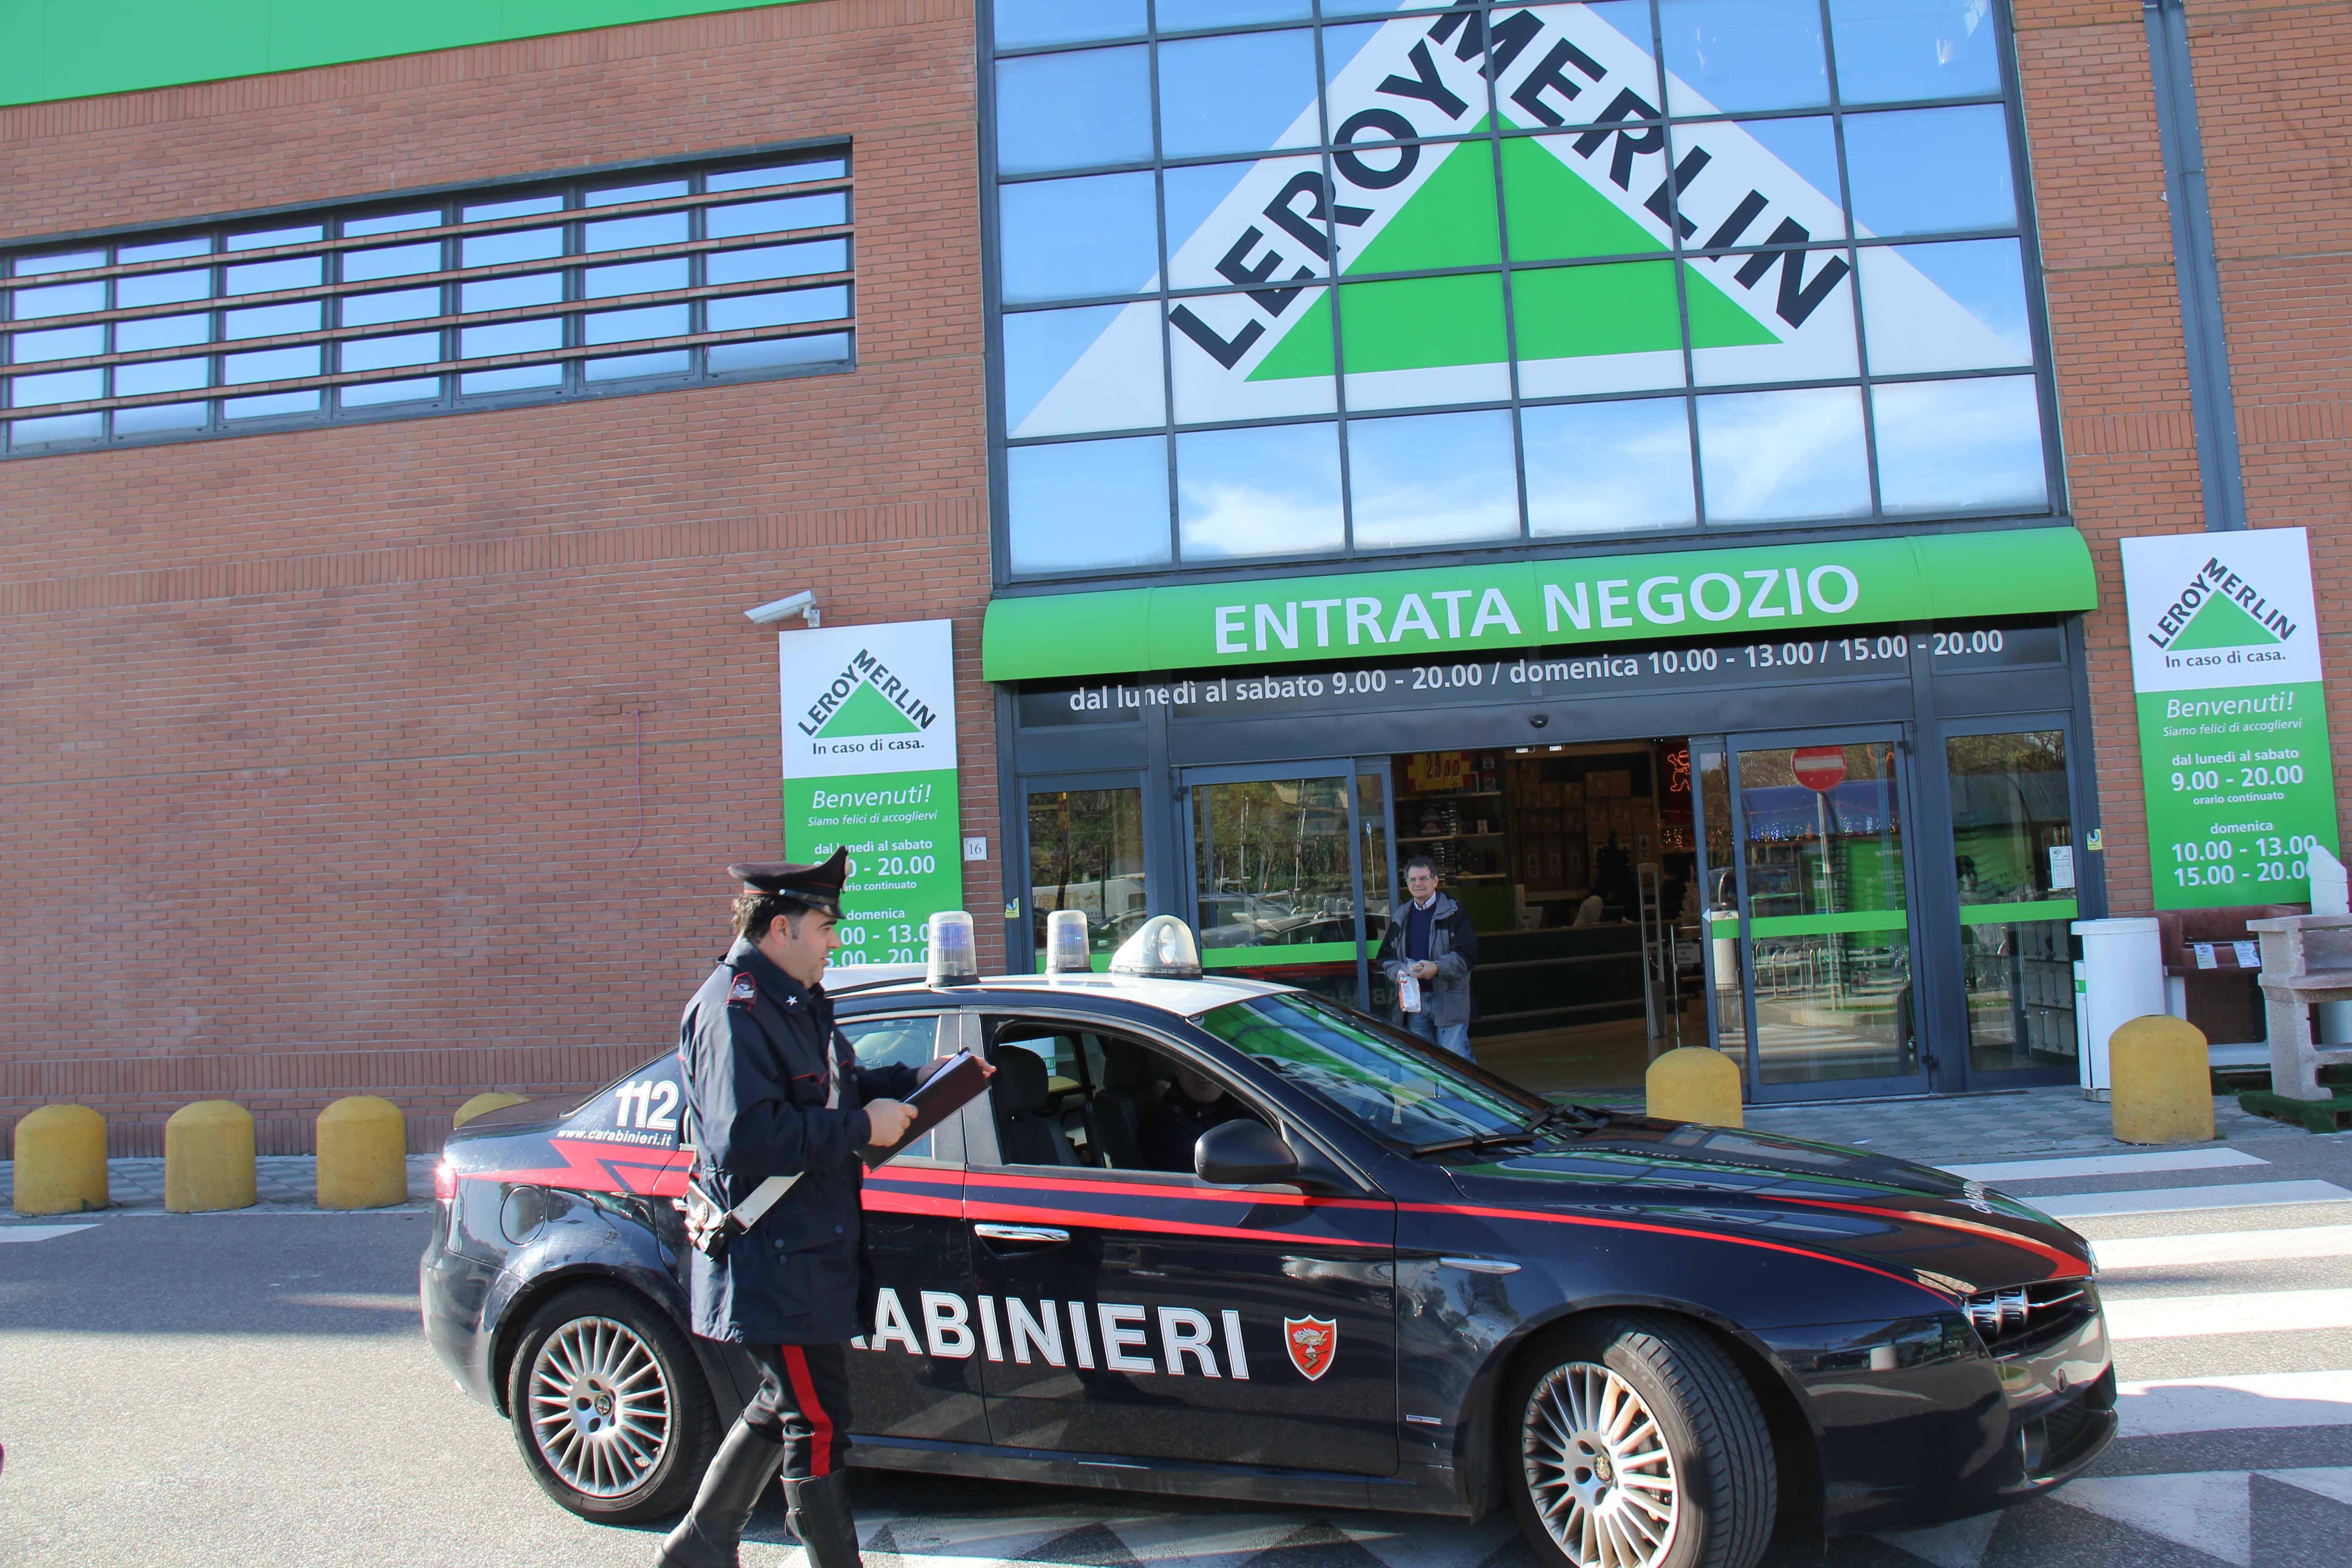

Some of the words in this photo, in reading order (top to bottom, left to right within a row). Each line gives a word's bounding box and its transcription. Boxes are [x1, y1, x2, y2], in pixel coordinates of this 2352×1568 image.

[1169, 38, 1469, 370] LEROY
[1427, 0, 1850, 330] MERLIN
[1215, 588, 1521, 654] ENTRATA
[1544, 564, 1859, 632] NEGOZIO
[2147, 573, 2211, 649] LEROY
[2201, 557, 2297, 641] MERLIN
[2166, 655, 2180, 668] In
[2186, 654, 2221, 667] caso
[2227, 651, 2241, 663] di
[2247, 651, 2286, 663] casa.
[1070, 686, 1108, 711] dal
[1117, 685, 1197, 709] lunedì
[1205, 679, 1228, 703] al
[1235, 674, 1324, 701] sabato
[1332, 669, 1386, 696] 9.00
[1412, 663, 1482, 691] 20.00
[1509, 654, 1638, 684] domenica
[1648, 649, 1717, 675] 10.00
[1744, 640, 1814, 668] 13.00
[1839, 635, 1907, 662] 15.00
[1933, 629, 2004, 657] 20.00
[798, 664, 859, 736] LEROY
[853, 648, 936, 730] MERLIN
[2166, 691, 2294, 719] Benvenuti!
[2163, 725, 2196, 737] Siamo
[2200, 723, 2226, 735] felici
[2229, 721, 2239, 732] di
[2242, 718, 2302, 733] accogliervi
[813, 743, 826, 755] In
[832, 743, 864, 753] caso
[870, 739, 882, 751] di
[888, 740, 925, 750] casa.
[2171, 755, 2192, 766] dal
[2195, 751, 2236, 764] lunedì
[2239, 751, 2251, 762] al
[2254, 748, 2299, 760] sabato
[2171, 770, 2219, 791] 9.00
[2240, 765, 2303, 787] 20.00
[812, 784, 931, 809] Benvenuti!
[2193, 795, 2225, 805] orario
[2228, 791, 2284, 803] continuato
[808, 817, 839, 826] Siamo
[842, 814, 867, 824] felici
[870, 813, 880, 823] di
[882, 810, 938, 823] accogliervi
[2210, 820, 2274, 834] domenica
[814, 843, 833, 854] dal
[878, 840, 888, 851] al
[892, 839, 932, 851] sabato
[970, 843, 982, 854] 16
[2172, 840, 2232, 862] 10.00
[878, 855, 935, 876] 20.00
[2174, 865, 2234, 887] 15.00
[2256, 860, 2311, 882] 20.0
[864, 881, 916, 890] continuato
[847, 908, 905, 921] domenica
[888, 923, 929, 943] 13.0
[615, 1080, 679, 1131] 112
[557, 1129, 672, 1147] www.carabinieri.it
[850, 1288, 1250, 1381] ABINIERI
